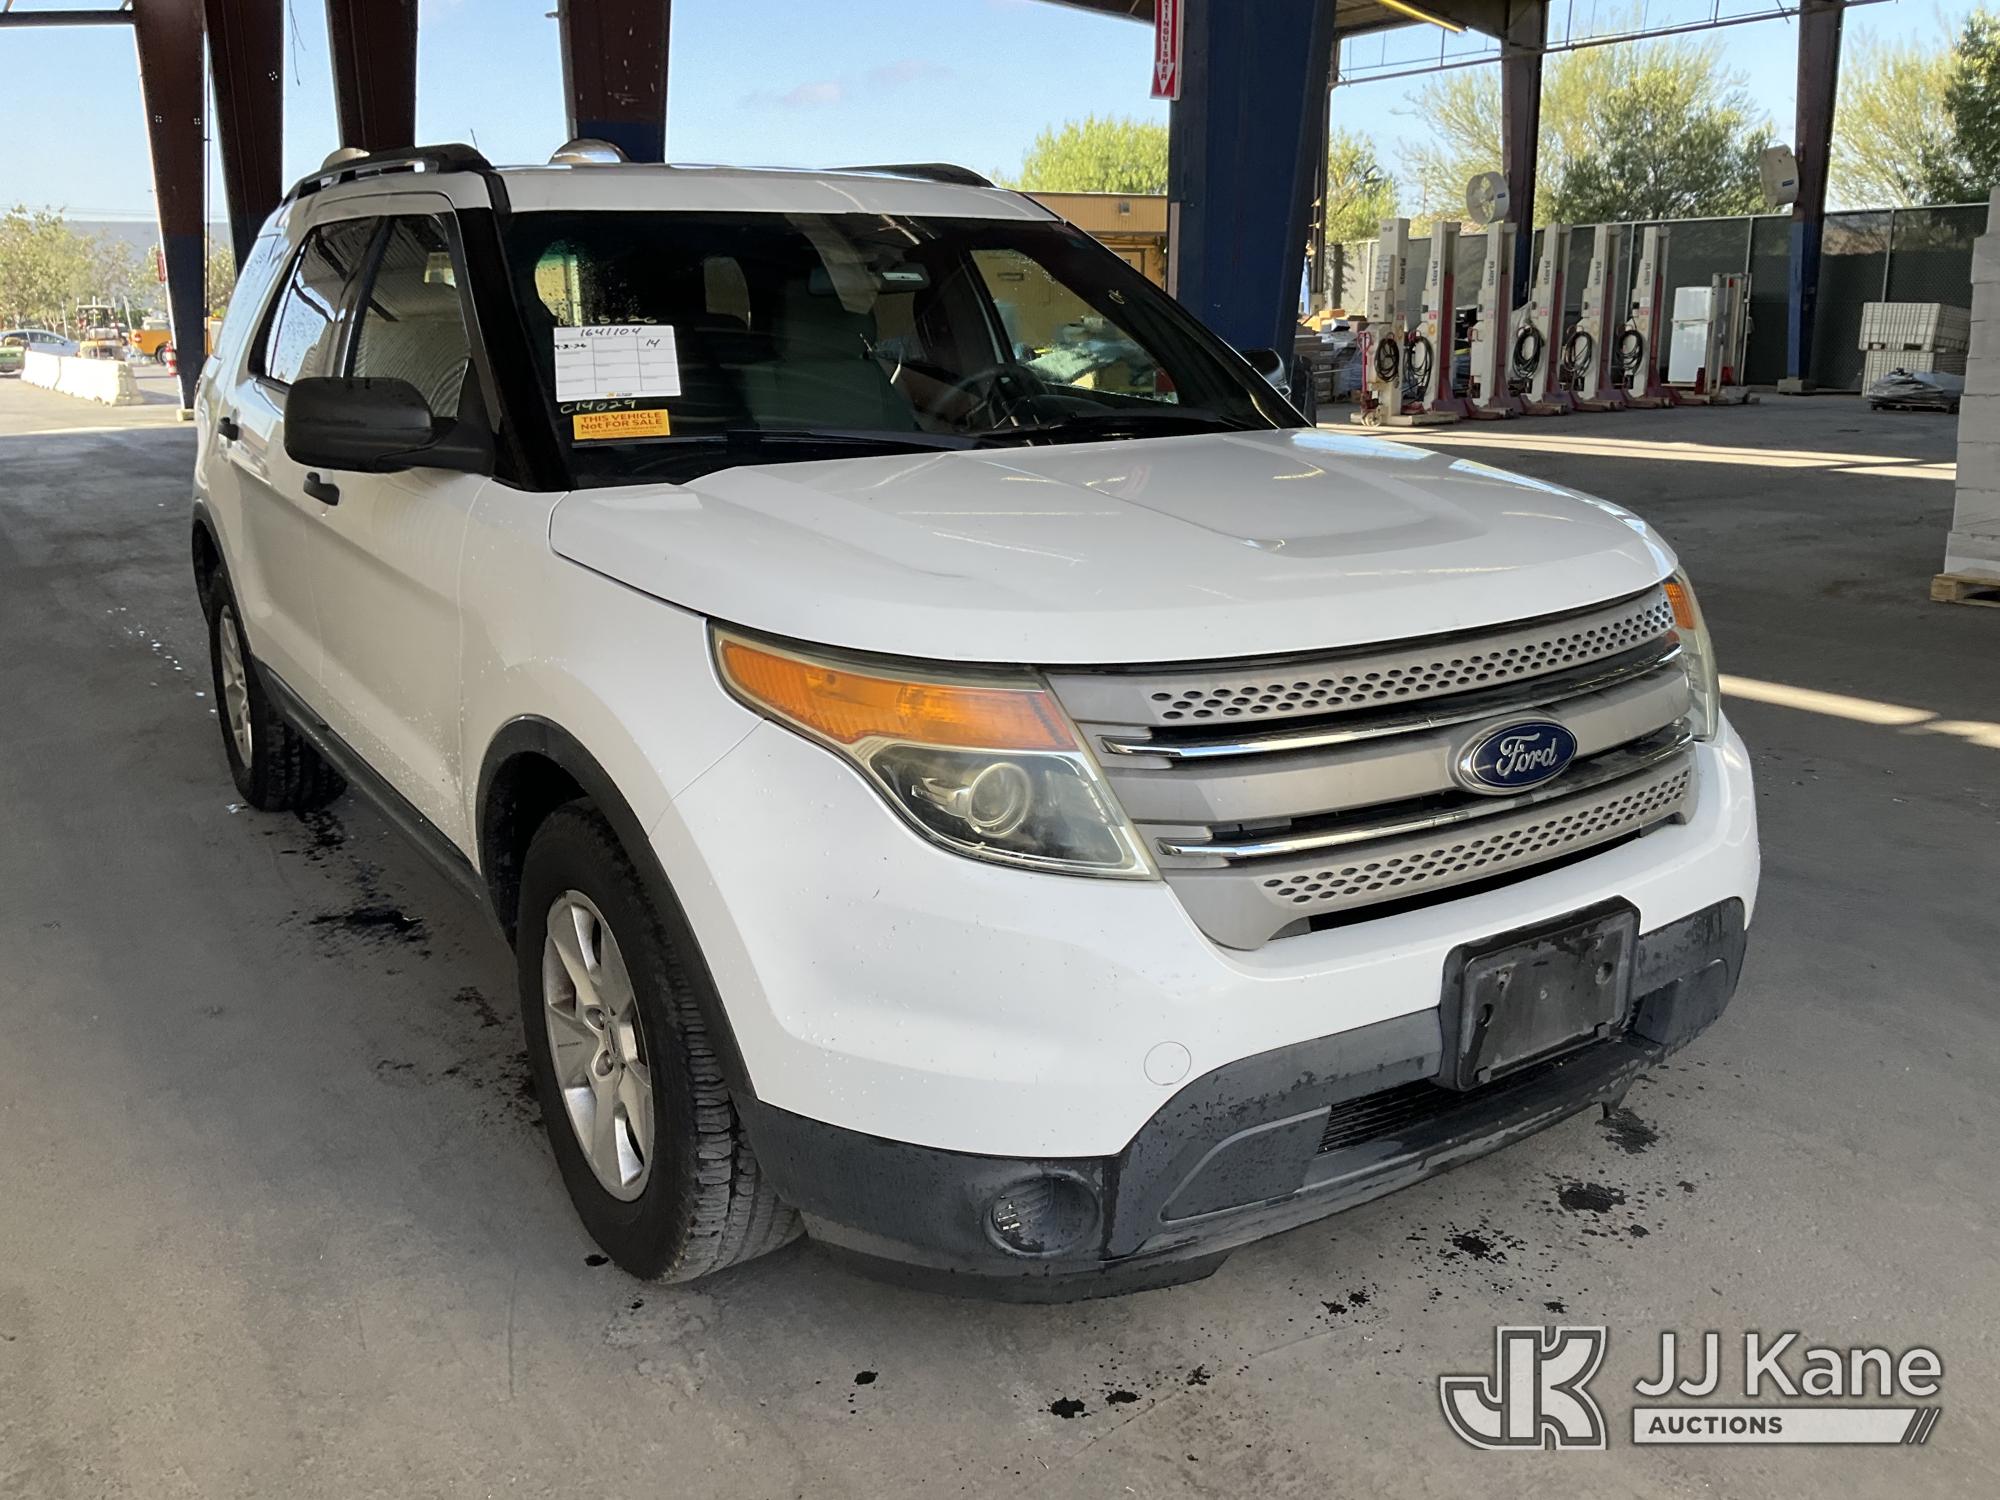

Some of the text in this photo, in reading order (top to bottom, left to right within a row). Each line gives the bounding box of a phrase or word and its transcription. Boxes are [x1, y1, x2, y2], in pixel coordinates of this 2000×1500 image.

[646, 339, 660, 348] 14
[581, 412, 662, 423] THIS VEHICLE
[581, 423, 603, 431] Not
[605, 420, 629, 428] FOR
[632, 418, 662, 426] SALE
[1496, 733, 1558, 777] Ford
